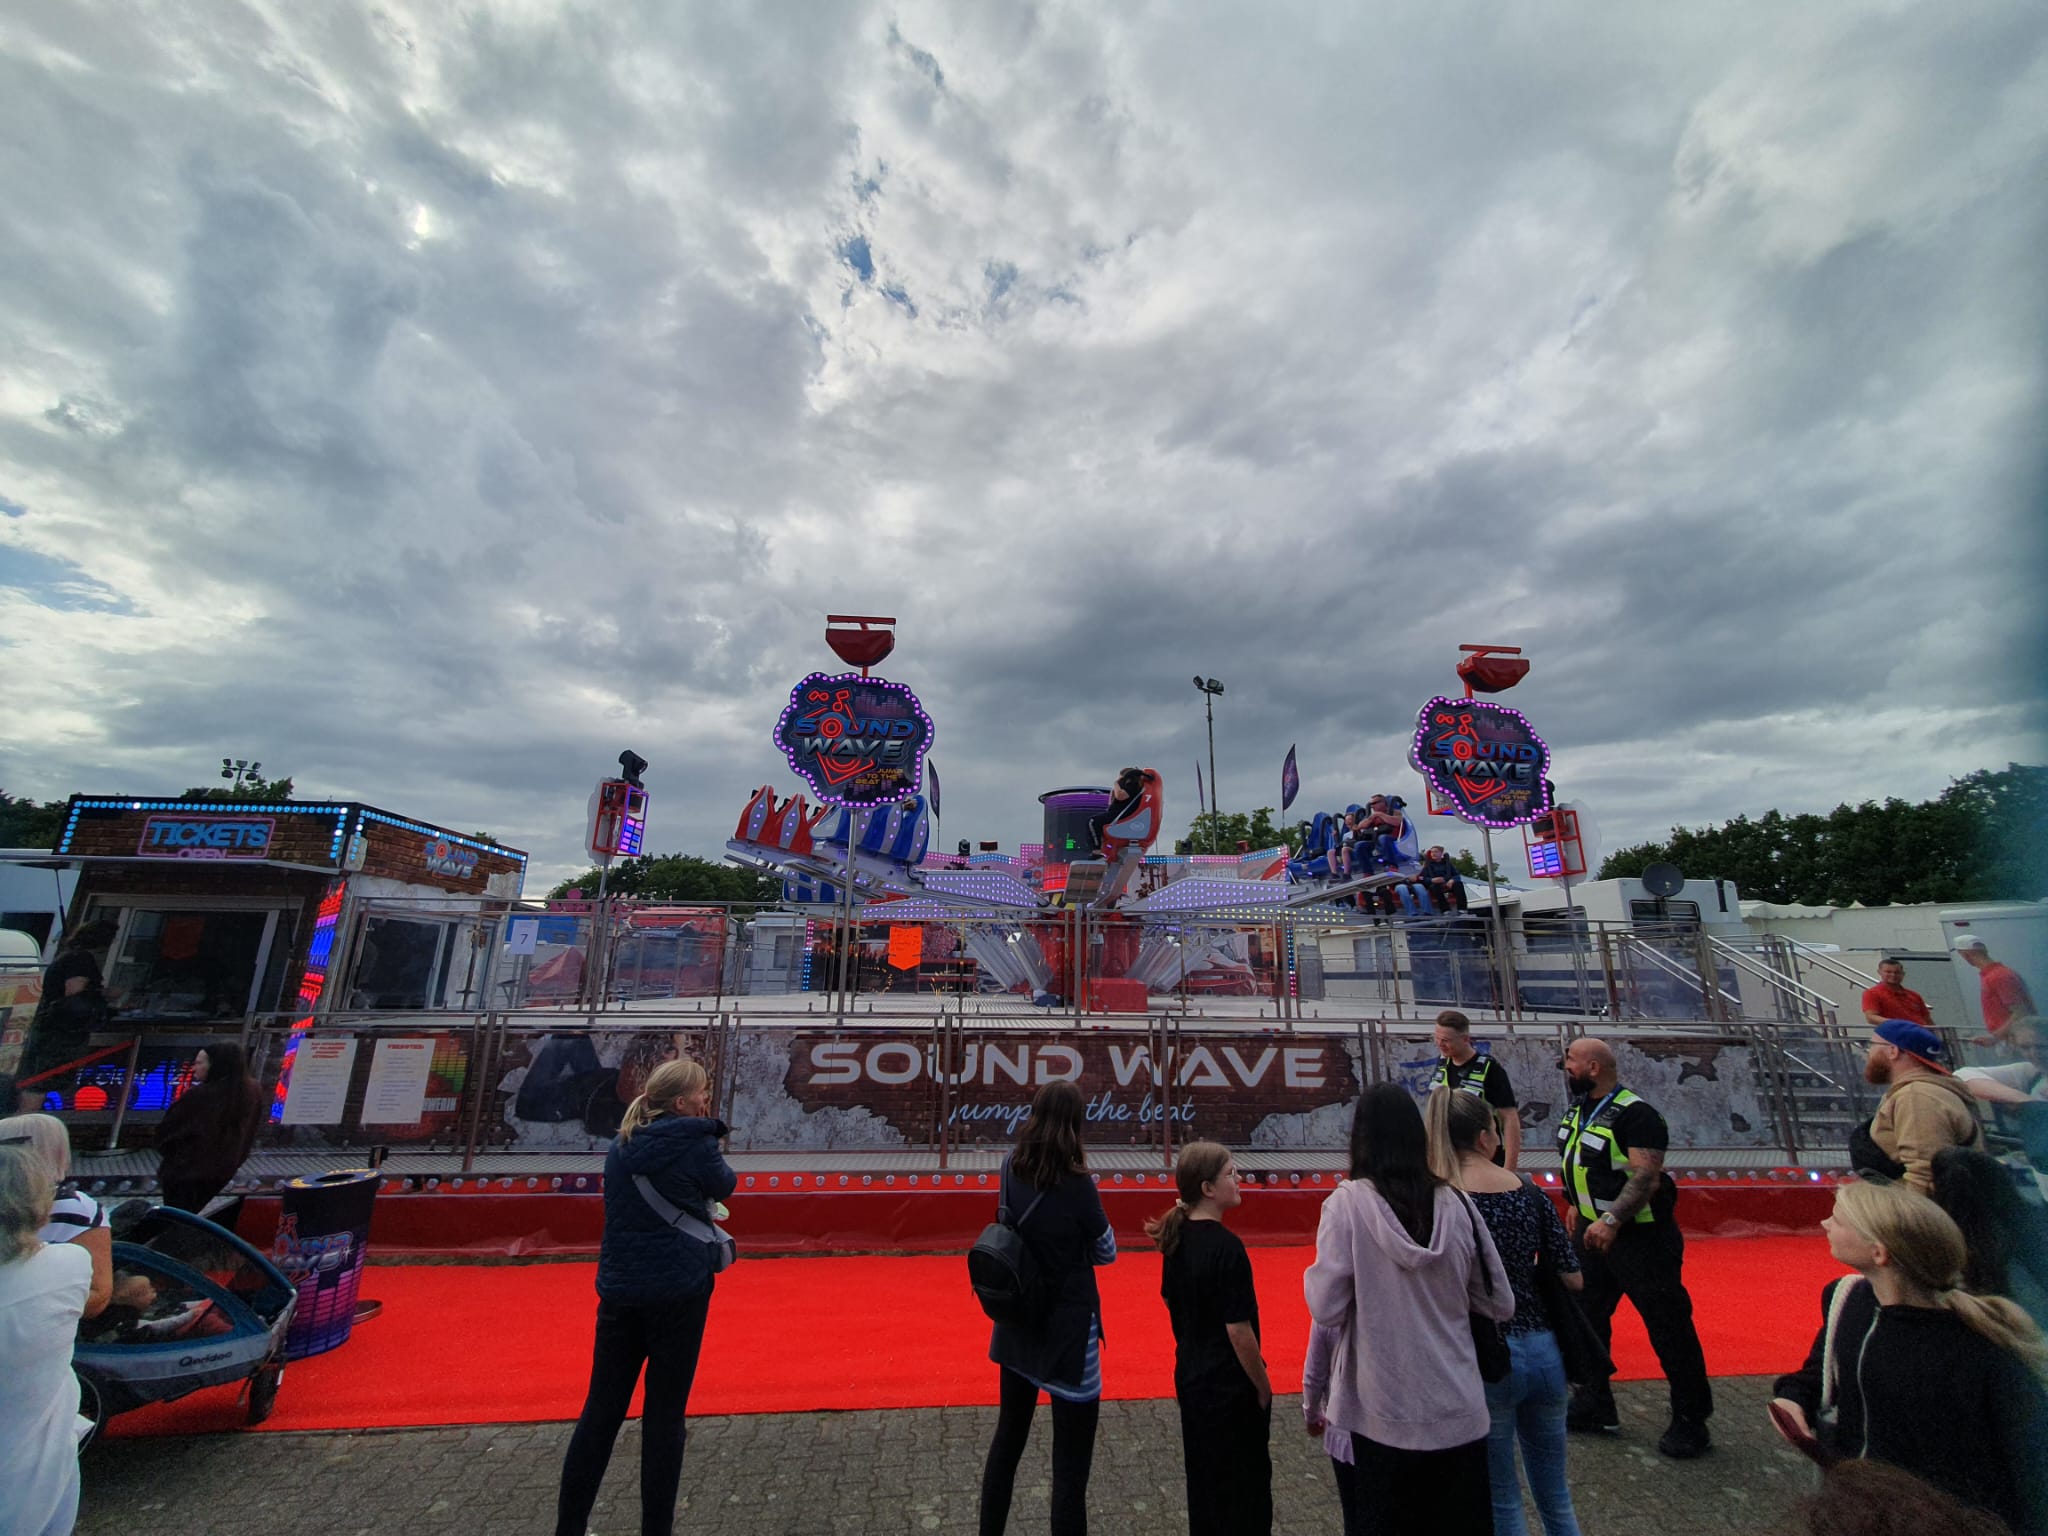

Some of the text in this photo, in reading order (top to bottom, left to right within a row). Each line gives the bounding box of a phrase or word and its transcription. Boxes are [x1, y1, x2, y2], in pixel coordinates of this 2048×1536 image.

[796, 715, 916, 739] SOUND
[803, 737, 904, 758] WAVE
[1433, 737, 1539, 760] SOUND
[1444, 759, 1532, 779] WAVE
[1144, 794, 1152, 803] 7
[149, 822, 269, 847] TICKETS
[178, 848, 227, 859] OPEN
[424, 838, 479, 866] SOUND
[426, 856, 474, 879] WAVE
[520, 933, 528, 945] 7
[808, 1042, 1084, 1086] SOUND
[1108, 1045, 1327, 1088] WAVE
[1085, 1090, 1132, 1121] the
[1138, 1092, 1197, 1122] beat
